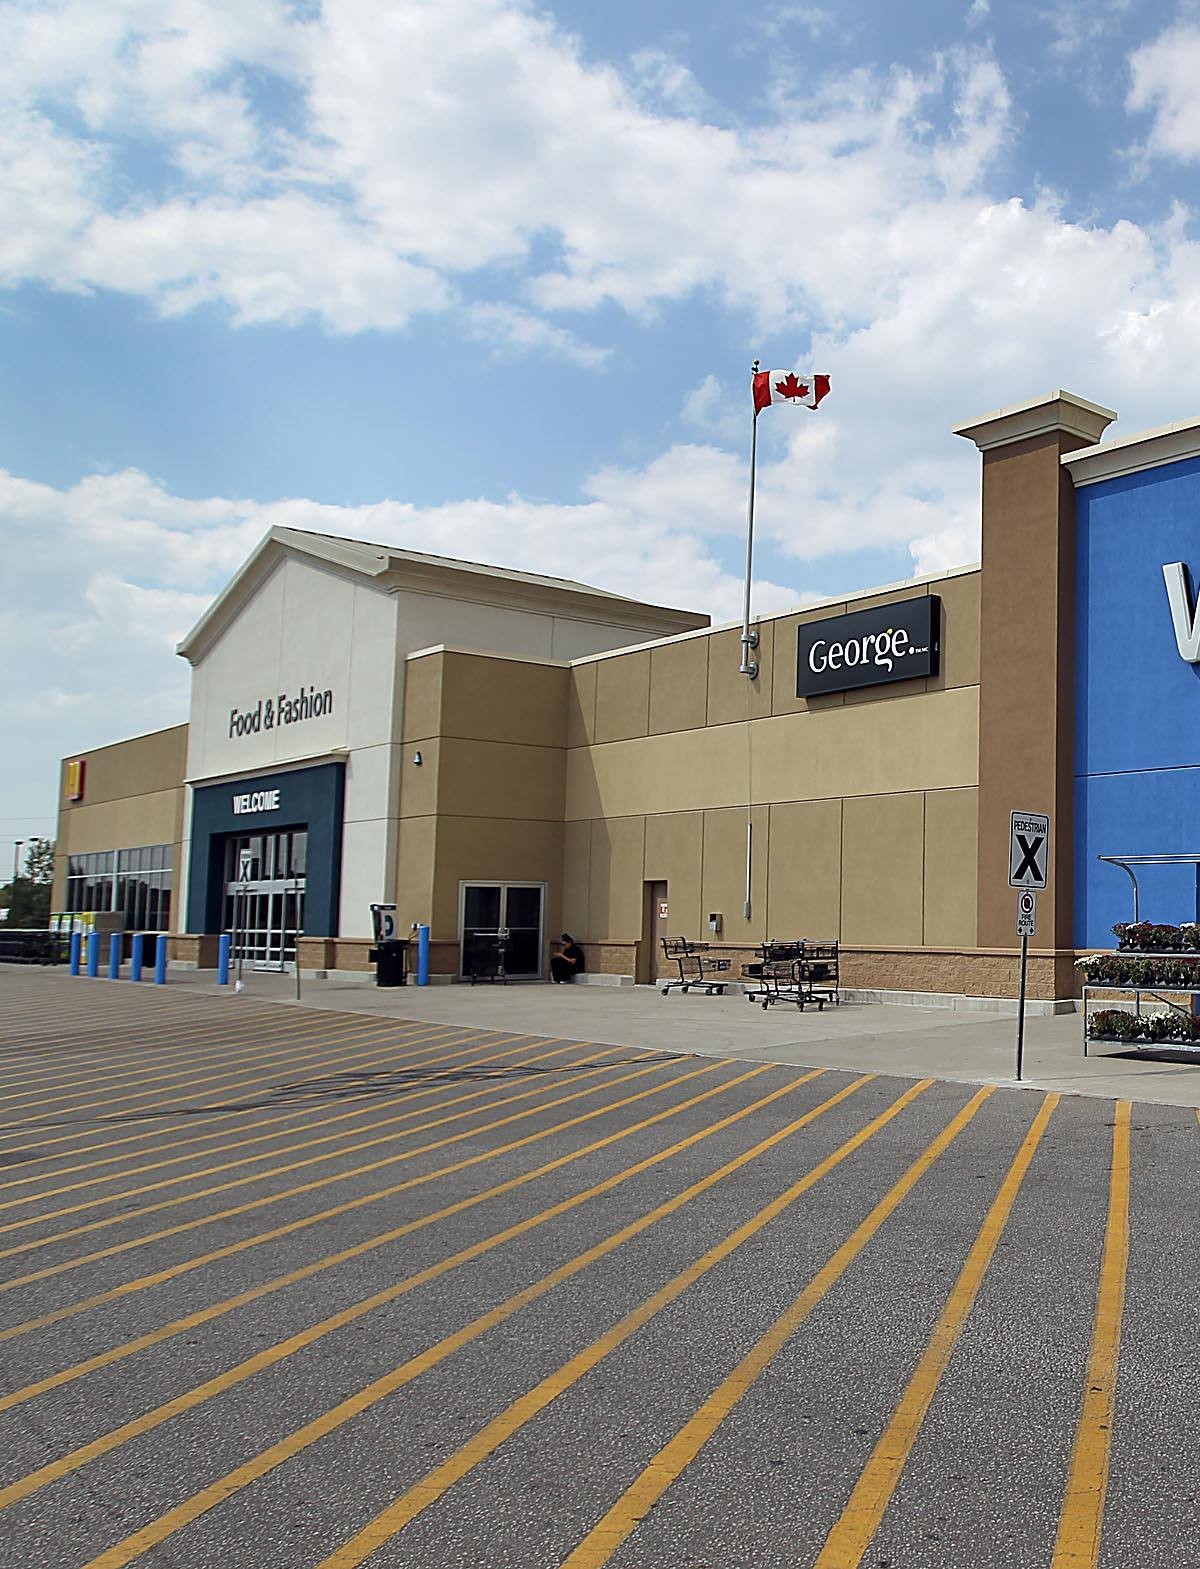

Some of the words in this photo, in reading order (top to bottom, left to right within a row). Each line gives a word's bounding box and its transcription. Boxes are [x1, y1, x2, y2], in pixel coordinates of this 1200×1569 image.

[229, 700, 262, 739] Food
[264, 699, 275, 730] &
[277, 686, 333, 726] Fashion
[233, 789, 280, 815] WELCOME
[1013, 820, 1047, 834] PEDESTRIAN
[1012, 834, 1045, 881] X
[1018, 919, 1034, 927] ROUTE
